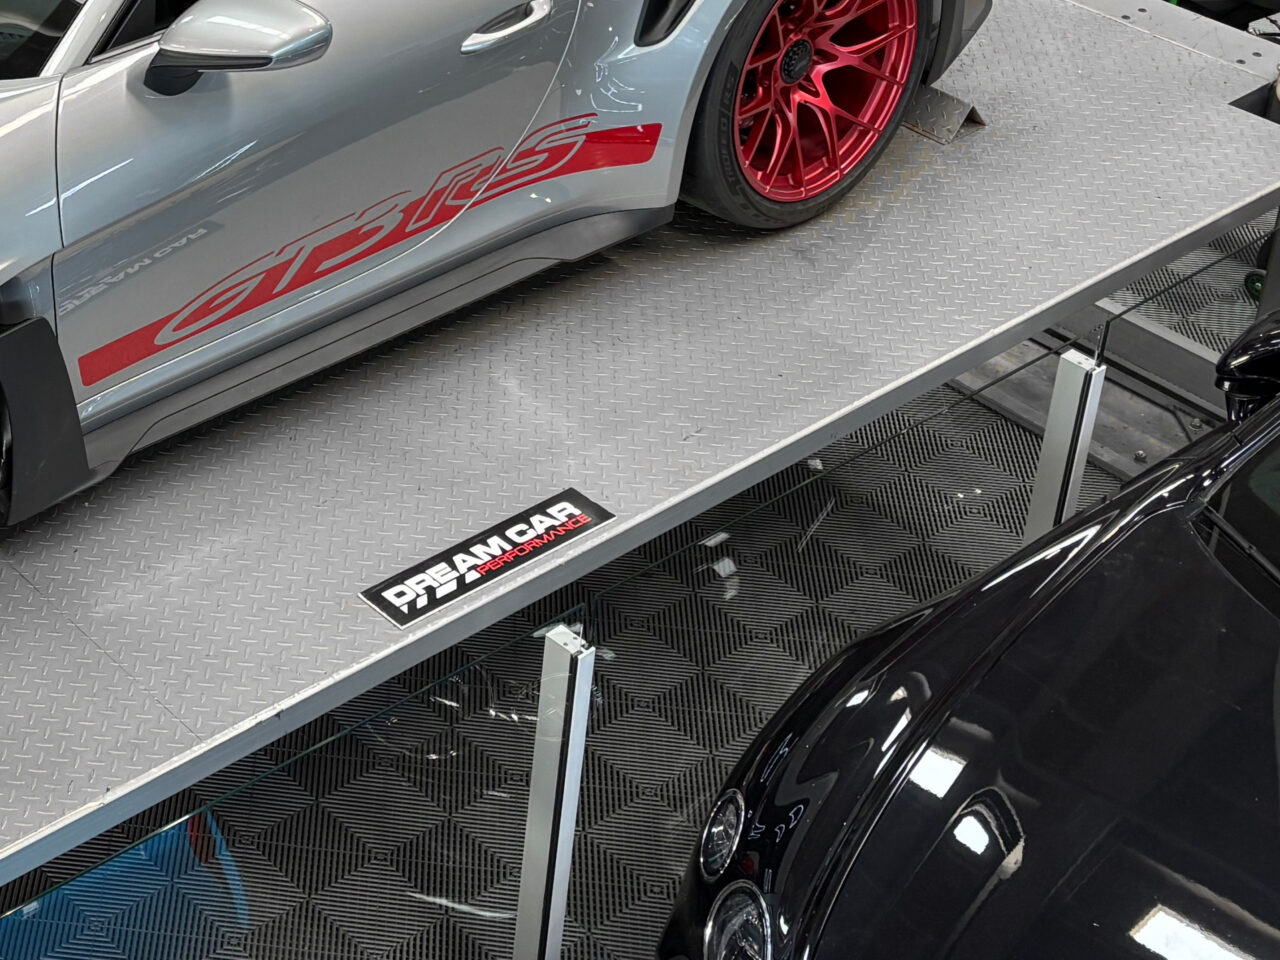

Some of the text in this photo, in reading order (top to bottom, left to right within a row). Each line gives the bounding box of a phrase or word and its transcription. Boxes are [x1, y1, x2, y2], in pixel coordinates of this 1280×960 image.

[381, 501, 583, 608] DREAM CAR
[477, 513, 593, 577] PERFORMANCE
